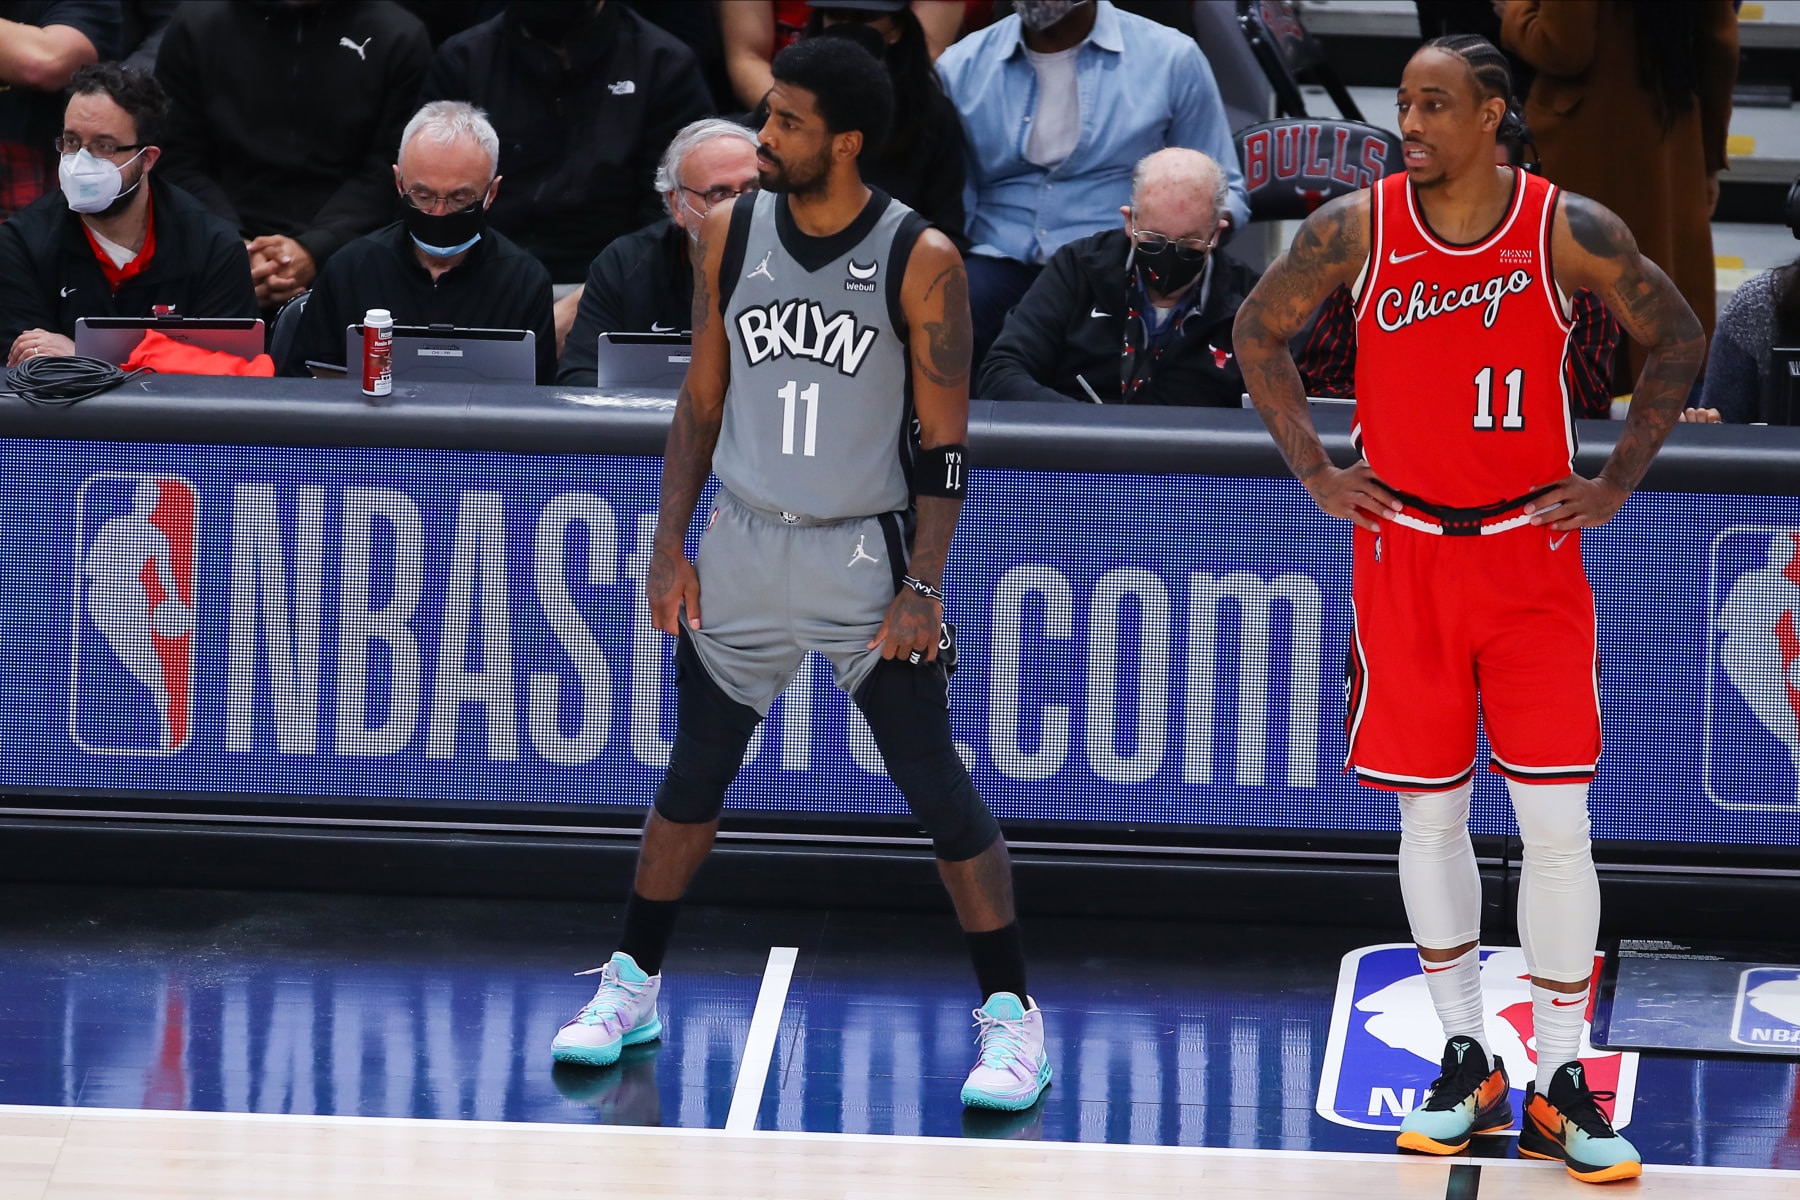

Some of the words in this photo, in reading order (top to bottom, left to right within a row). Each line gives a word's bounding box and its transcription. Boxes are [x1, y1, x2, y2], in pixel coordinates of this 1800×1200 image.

[1244, 125, 1388, 194] BULLS
[1500, 249, 1532, 257] ZENNI
[846, 281, 875, 292] Webull
[1376, 269, 1533, 332] Chicago
[736, 299, 879, 377] BKLYN
[777, 380, 820, 457] 11
[1473, 366, 1525, 431] 11
[945, 452, 962, 464] KAI
[945, 464, 961, 490] 11
[224, 482, 1320, 788] NBAStcom
